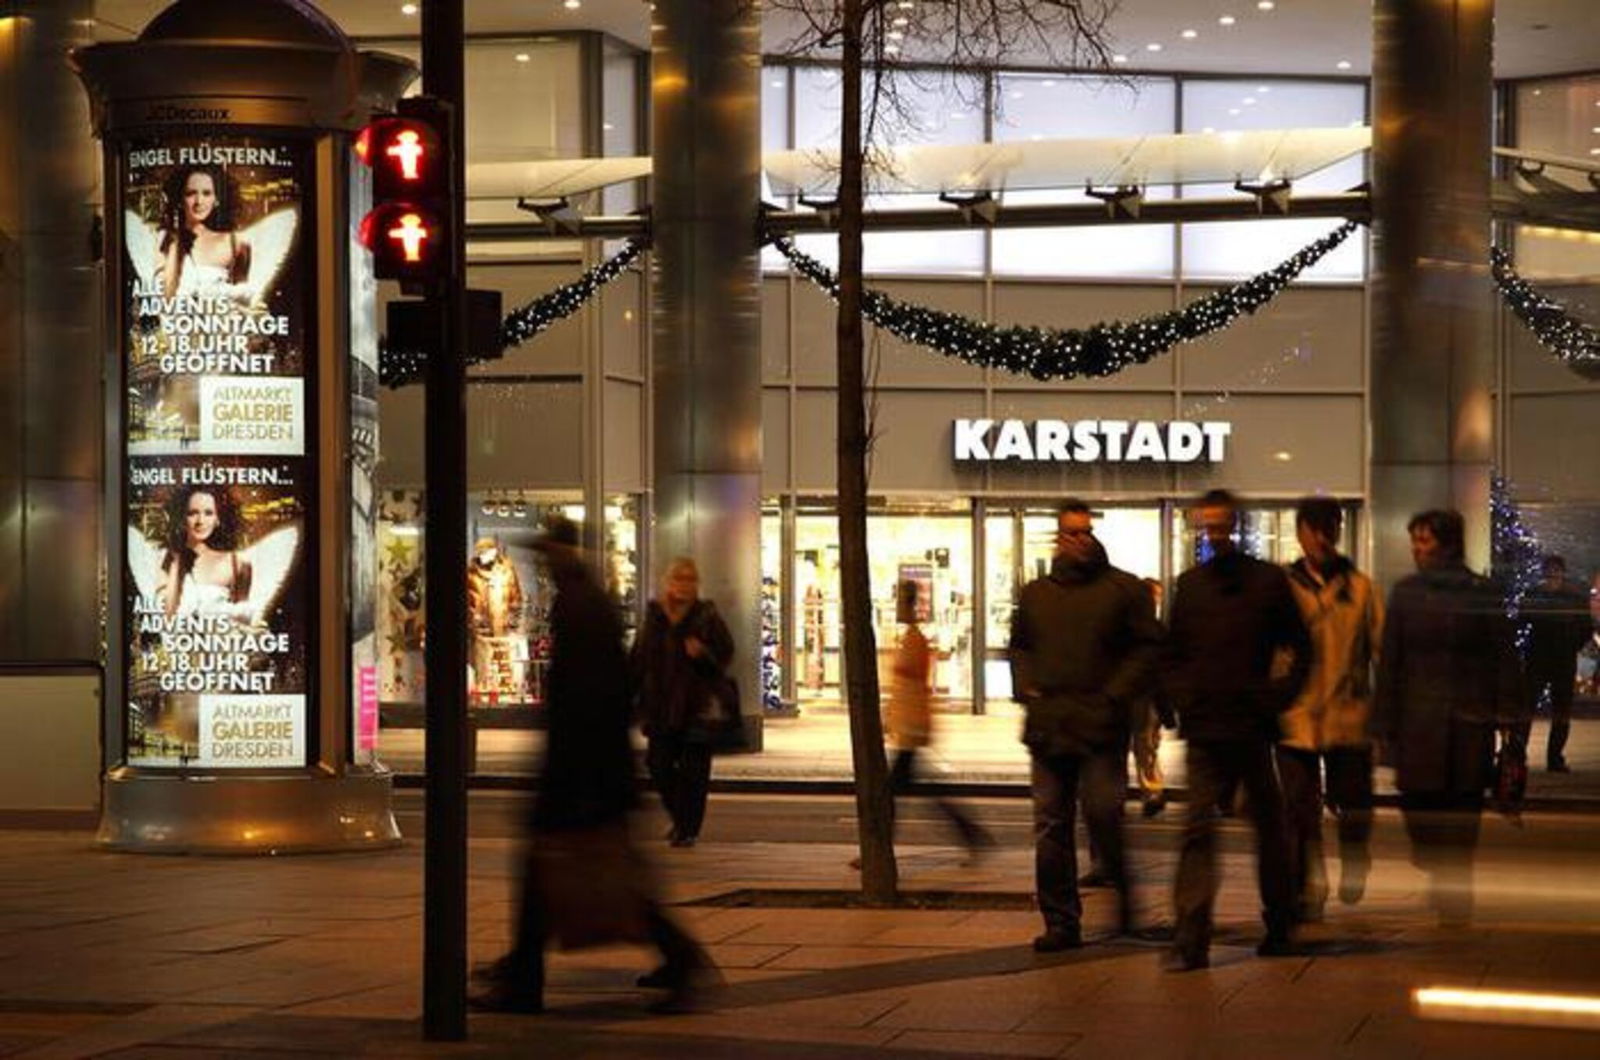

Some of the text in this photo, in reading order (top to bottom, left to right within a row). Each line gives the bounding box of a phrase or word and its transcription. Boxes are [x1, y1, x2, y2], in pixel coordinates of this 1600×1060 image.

[129, 143, 293, 167] ENGEL FLÜSTERN...
[132, 280, 165, 297] ALLE
[163, 315, 290, 336] SONNTAGE
[200, 335, 249, 353] UHR
[160, 350, 275, 374] GEÖFFNET
[213, 386, 293, 401] ALTMARKT
[213, 404, 294, 422] GALERIE
[213, 424, 294, 440] DRESDEN
[953, 418, 1231, 462] KARSTADT
[131, 463, 294, 485] ENGEL FLÜSTERN...
[133, 596, 165, 613] ALLE
[163, 633, 290, 653] SONNTAGE
[200, 653, 249, 671] UHR
[160, 668, 275, 691] GEÖFFNET
[212, 704, 292, 719] ALTMARKT
[212, 721, 294, 741] GALERIE
[212, 742, 294, 759] DRESDEN
